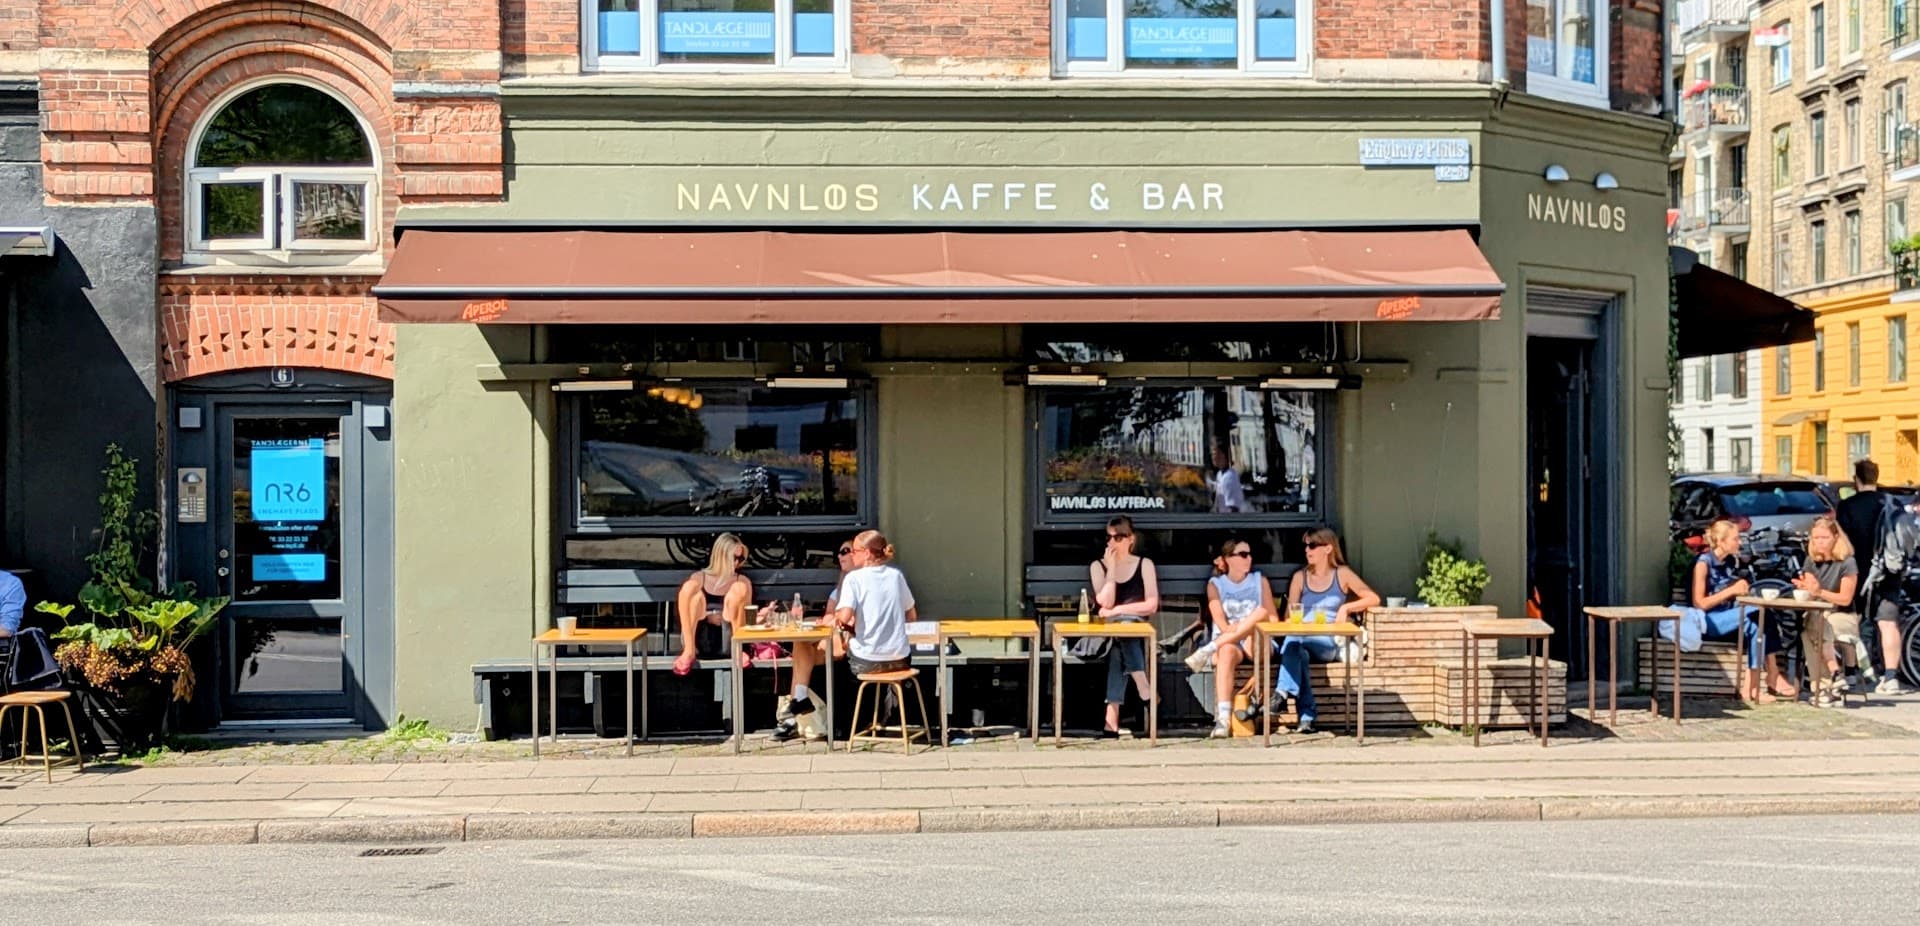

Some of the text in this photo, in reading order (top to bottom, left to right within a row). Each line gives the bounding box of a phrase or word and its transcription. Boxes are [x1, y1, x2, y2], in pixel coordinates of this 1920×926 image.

[677, 183, 1224, 211] NAVNLØS KAFFE & BAR
[462, 299, 508, 320] APEROL
[278, 369, 287, 382] 6
[1107, 496, 1165, 509] KAFFEBAR
